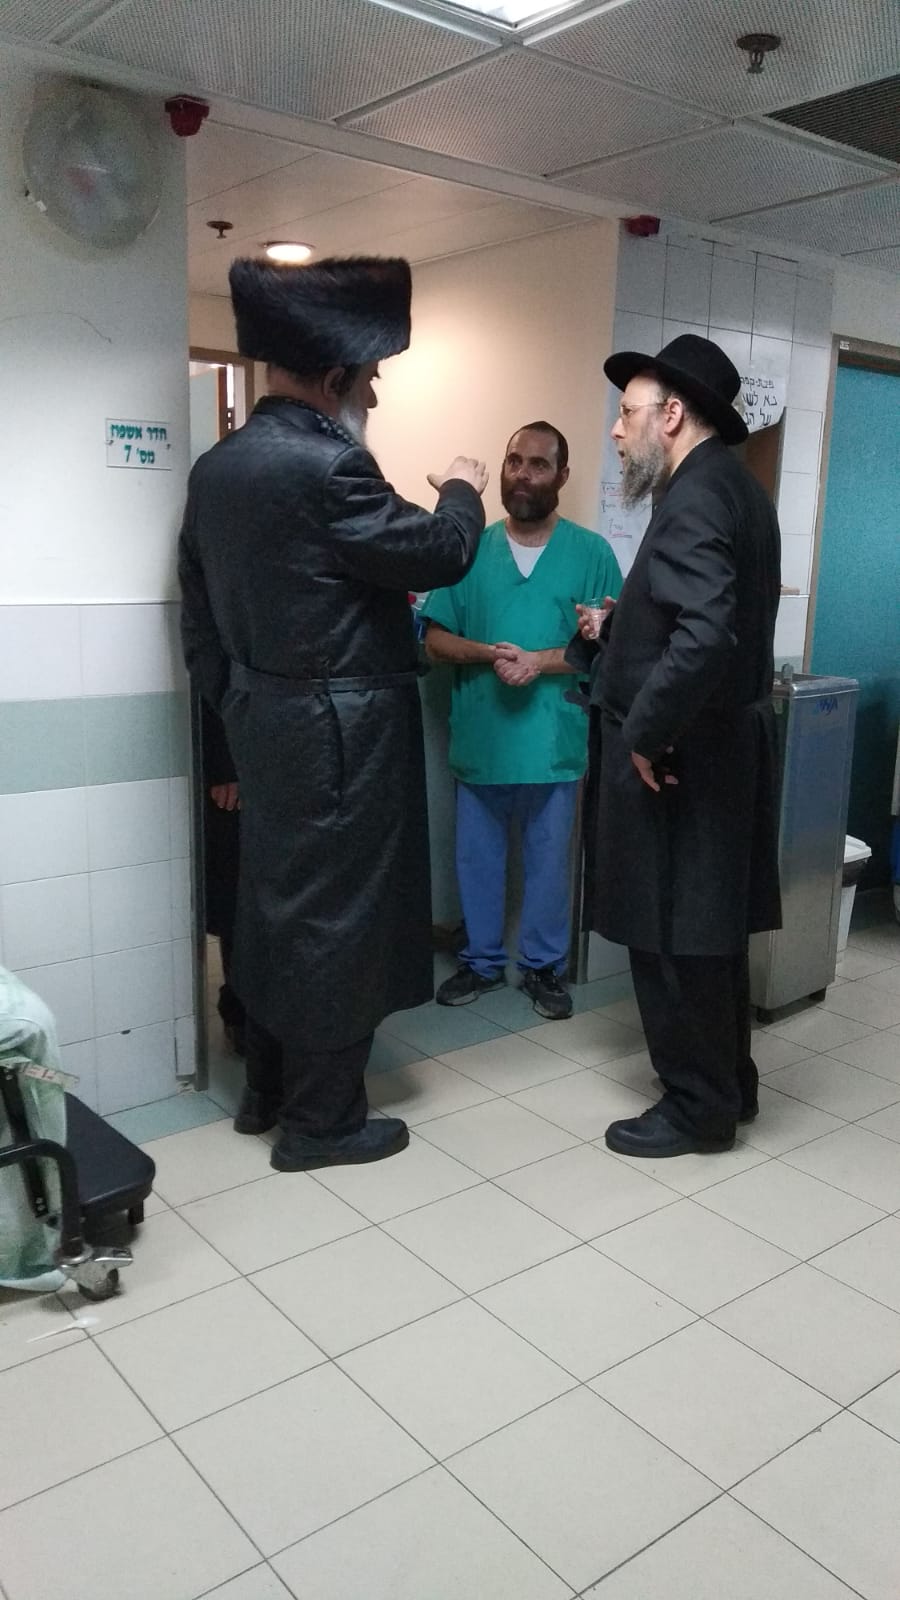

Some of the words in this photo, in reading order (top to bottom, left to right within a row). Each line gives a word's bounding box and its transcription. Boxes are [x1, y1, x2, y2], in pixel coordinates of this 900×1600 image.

[763, 394, 778, 407] נא
[111, 424, 142, 439] אשפוז
[147, 426, 167, 440] חדר
[124, 444, 132, 463] 7
[136, 448, 155, 464] מס'
